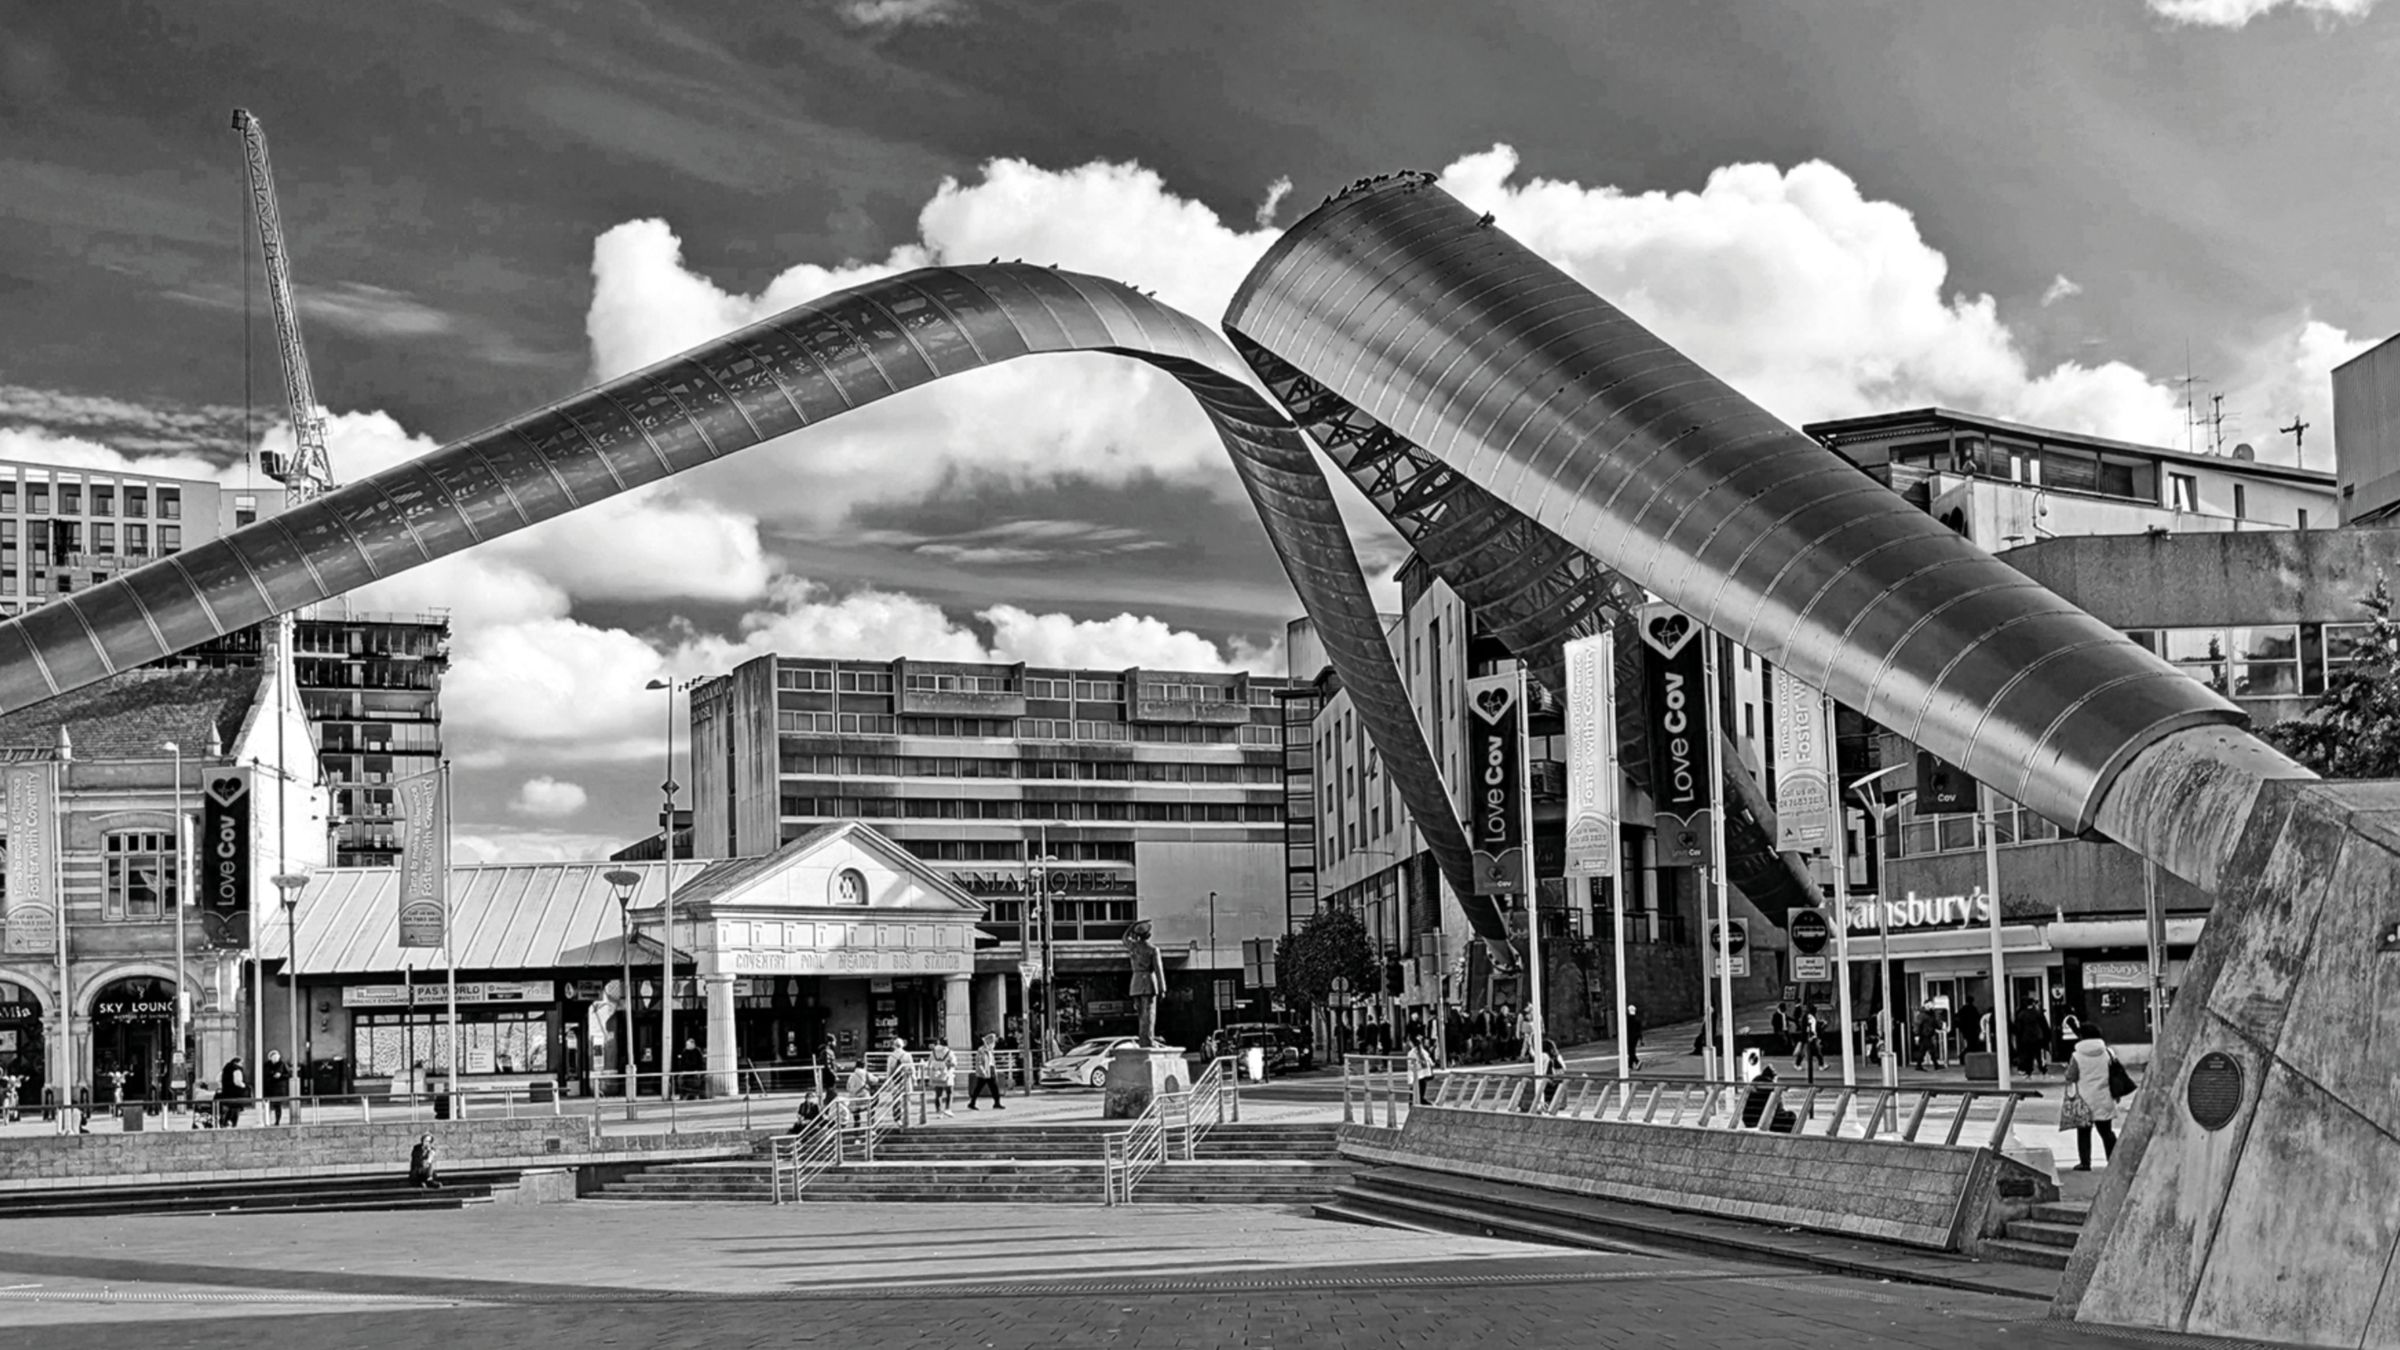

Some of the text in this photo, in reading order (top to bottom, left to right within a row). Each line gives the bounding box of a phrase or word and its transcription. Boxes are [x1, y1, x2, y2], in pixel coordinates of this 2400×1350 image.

[1582, 646, 1597, 807] Foster with Coventry
[1779, 707, 1788, 722] to
[1663, 672, 1695, 803] Love Cov
[1779, 725, 1789, 761] Time
[1795, 704, 1811, 764] Foster
[1484, 735, 1506, 842] Love Cov
[1938, 793, 1957, 802] Cov
[26, 771, 41, 899] Foster with Coventry
[421, 778, 434, 896] Foster with Coventry
[216, 815, 236, 906] Love Cov
[951, 870, 1127, 892] NNIA OTEL
[735, 954, 960, 969] COVENTRY POOL MEADOW BUS STATION
[2085, 963, 2138, 974] Sainsbury's
[417, 985, 480, 995] PAS WORLD
[0, 1005, 32, 1018] Mia
[99, 1002, 124, 1013] SKY
